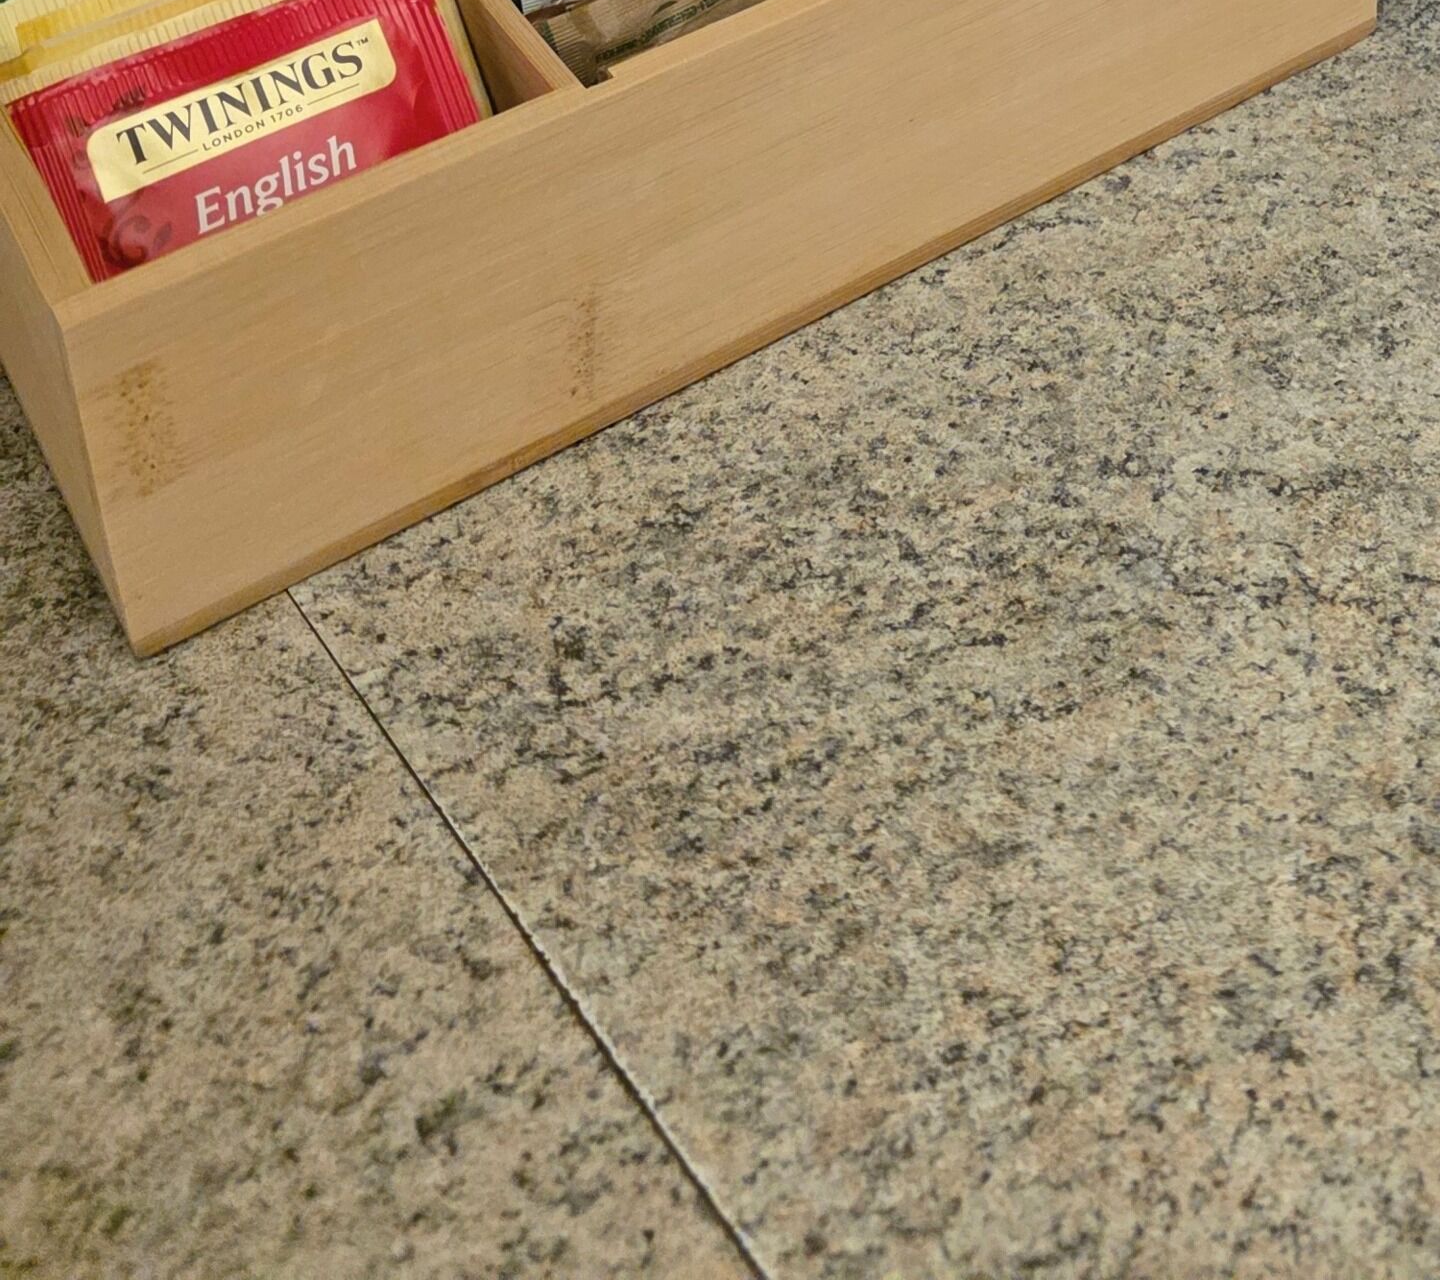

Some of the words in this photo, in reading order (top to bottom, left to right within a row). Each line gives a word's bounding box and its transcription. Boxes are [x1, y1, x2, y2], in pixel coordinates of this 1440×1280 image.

[116, 40, 363, 165] TWININGS
[202, 119, 266, 152] LONDON
[270, 103, 304, 124] 1706
[194, 135, 357, 234] English
